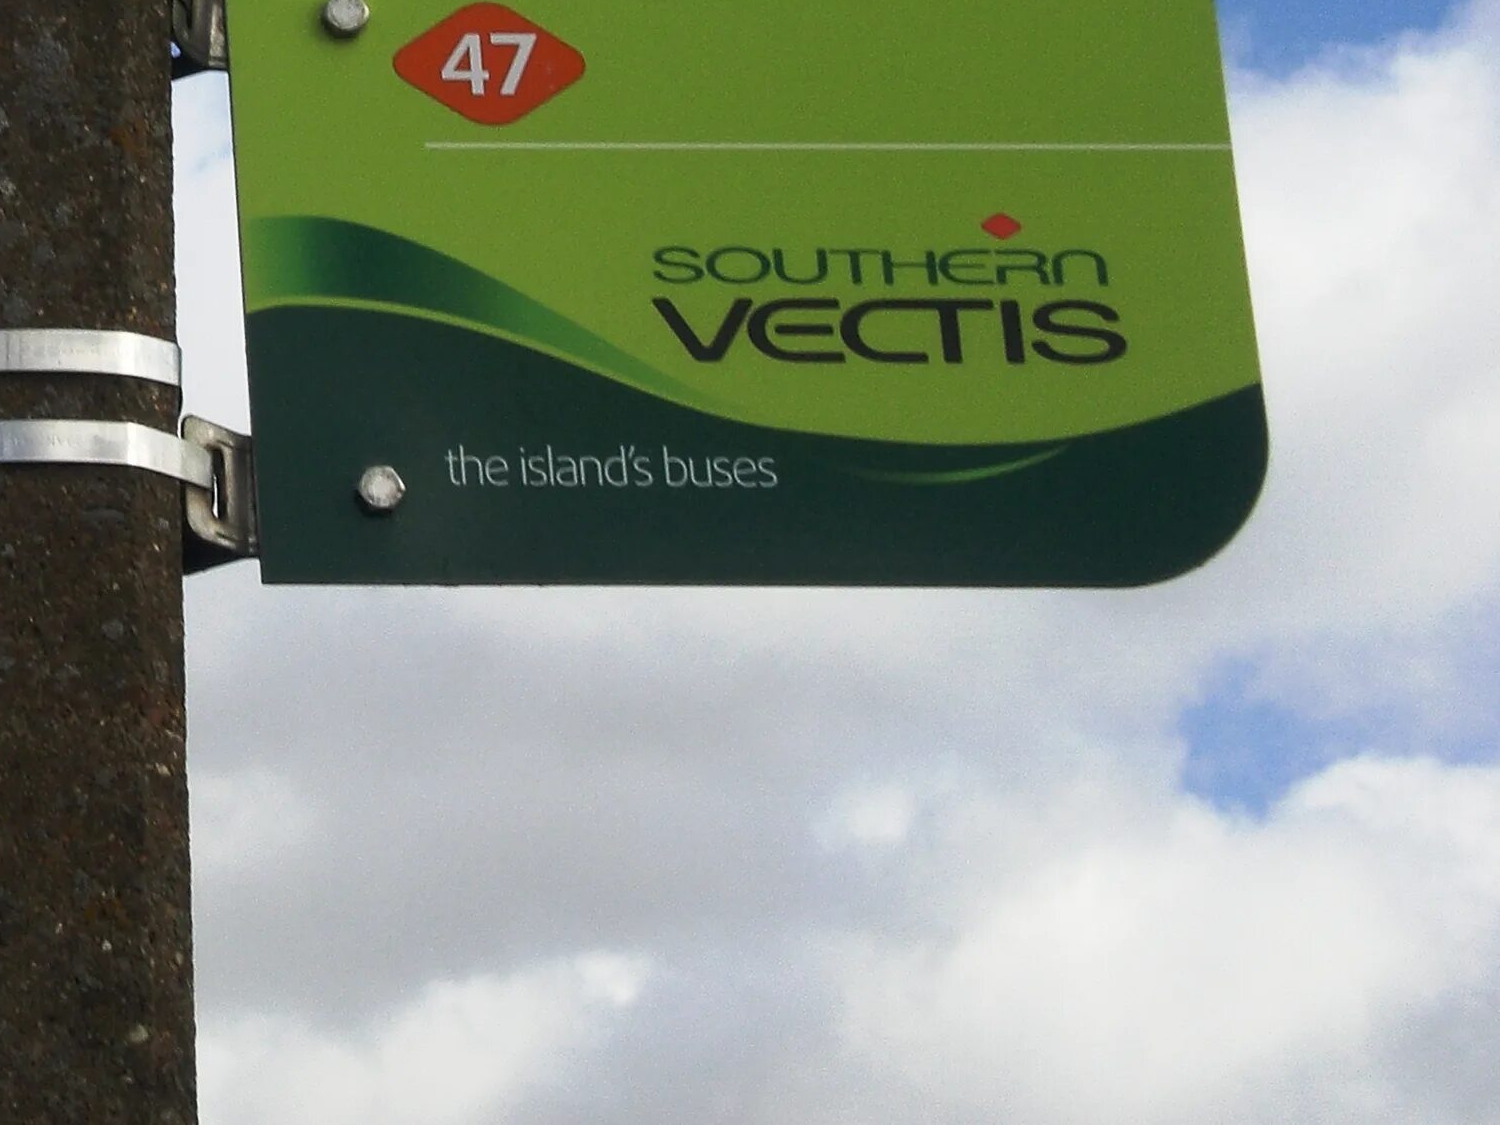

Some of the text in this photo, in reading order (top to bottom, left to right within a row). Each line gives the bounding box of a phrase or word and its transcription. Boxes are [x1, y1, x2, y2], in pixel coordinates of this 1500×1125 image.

[440, 32, 538, 96] 47
[651, 297, 1128, 366] VECTIS
[445, 445, 509, 487] the
[662, 445, 778, 488] buses
